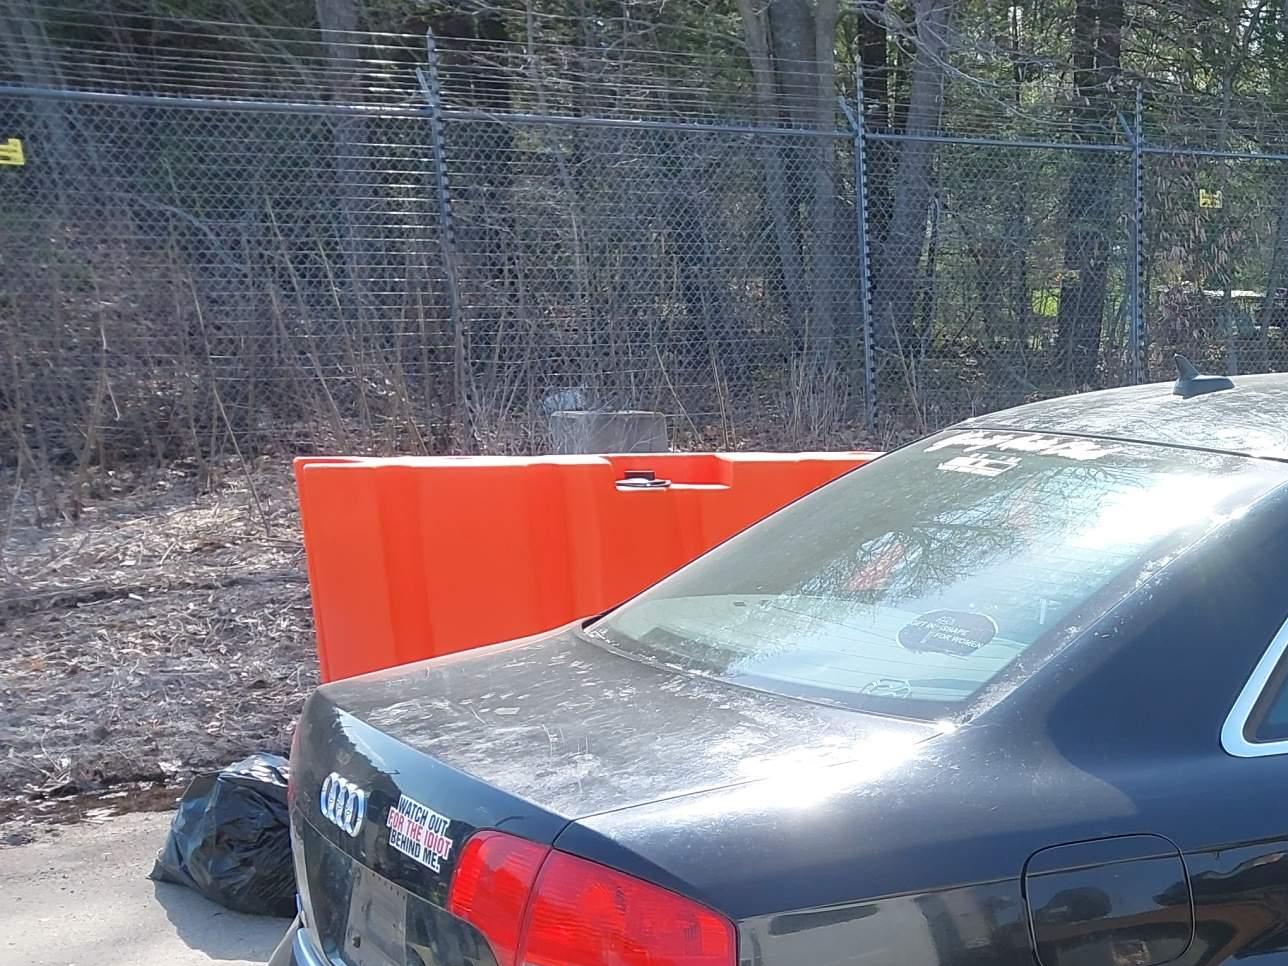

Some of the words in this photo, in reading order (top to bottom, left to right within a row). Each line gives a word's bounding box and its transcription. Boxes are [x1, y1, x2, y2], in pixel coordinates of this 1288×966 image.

[388, 809, 406, 828] FOR
[406, 819, 424, 842] THE
[424, 829, 451, 857] IDIOT
[399, 796, 427, 825] WATCH
[427, 814, 448, 835] OUT
[390, 829, 421, 858] BEHIND
[422, 849, 440, 870] ME.
